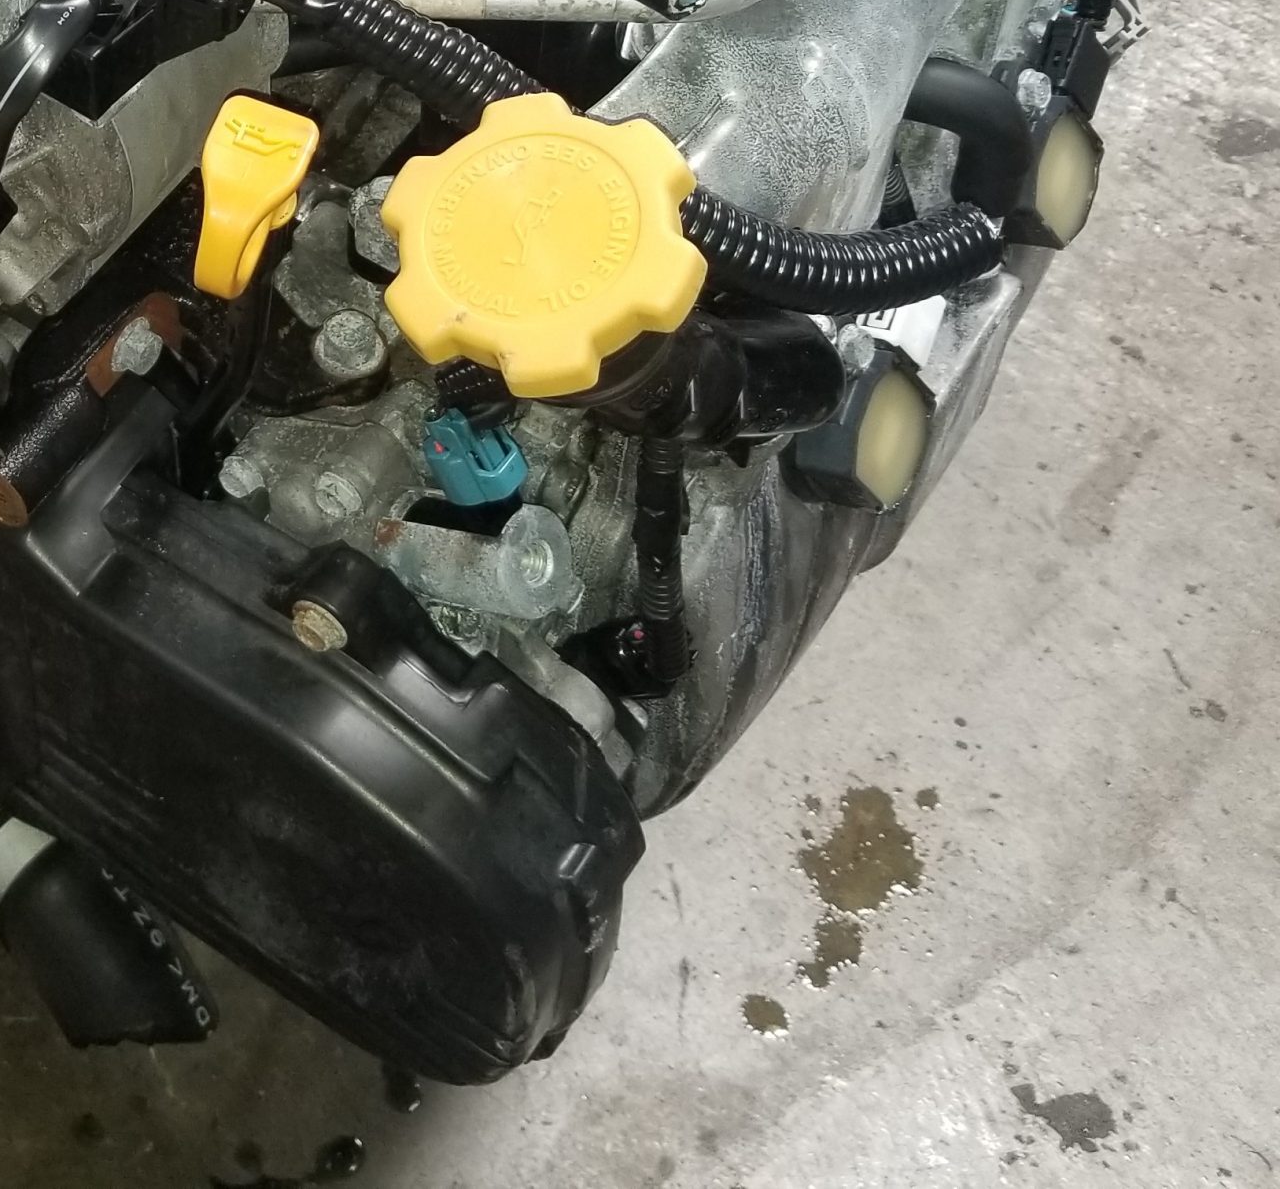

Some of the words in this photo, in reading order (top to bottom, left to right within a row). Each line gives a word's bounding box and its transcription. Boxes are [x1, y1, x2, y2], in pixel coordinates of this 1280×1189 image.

[542, 141, 598, 172] SEE
[591, 178, 632, 279] ENGINE
[433, 244, 521, 317] MANUAL
[538, 278, 592, 312] OIL
